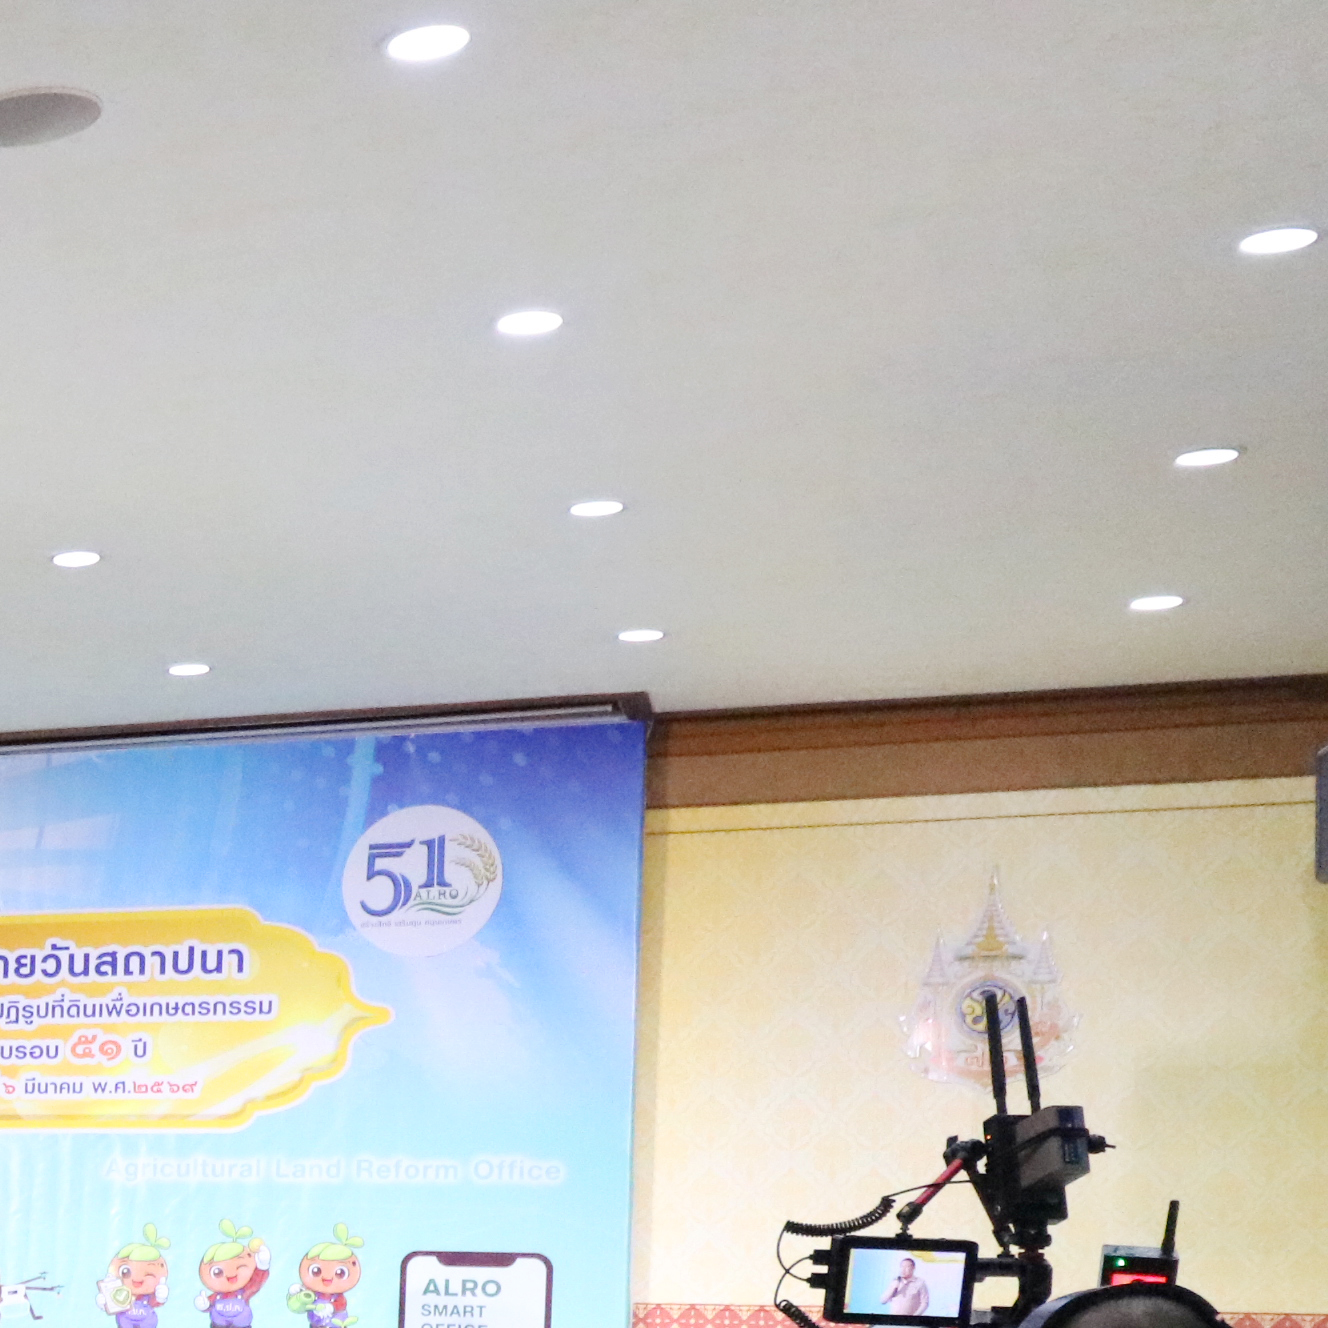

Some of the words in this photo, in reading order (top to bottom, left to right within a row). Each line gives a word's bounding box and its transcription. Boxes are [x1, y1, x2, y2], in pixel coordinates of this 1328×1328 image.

[360, 834, 452, 917] 51
[70, 1034, 122, 1061] ๕๑
[132, 1037, 147, 1059] ปี
[3, 1082, 16, 1095] ๖
[24, 1076, 83, 1095] มีนาคม
[104, 1158, 261, 1182] Agricultural
[275, 1158, 341, 1180] Land
[356, 1158, 459, 1181] Reform
[473, 1158, 562, 1182] Office
[421, 1278, 502, 1298] ALRO
[421, 1303, 487, 1318] SMART
